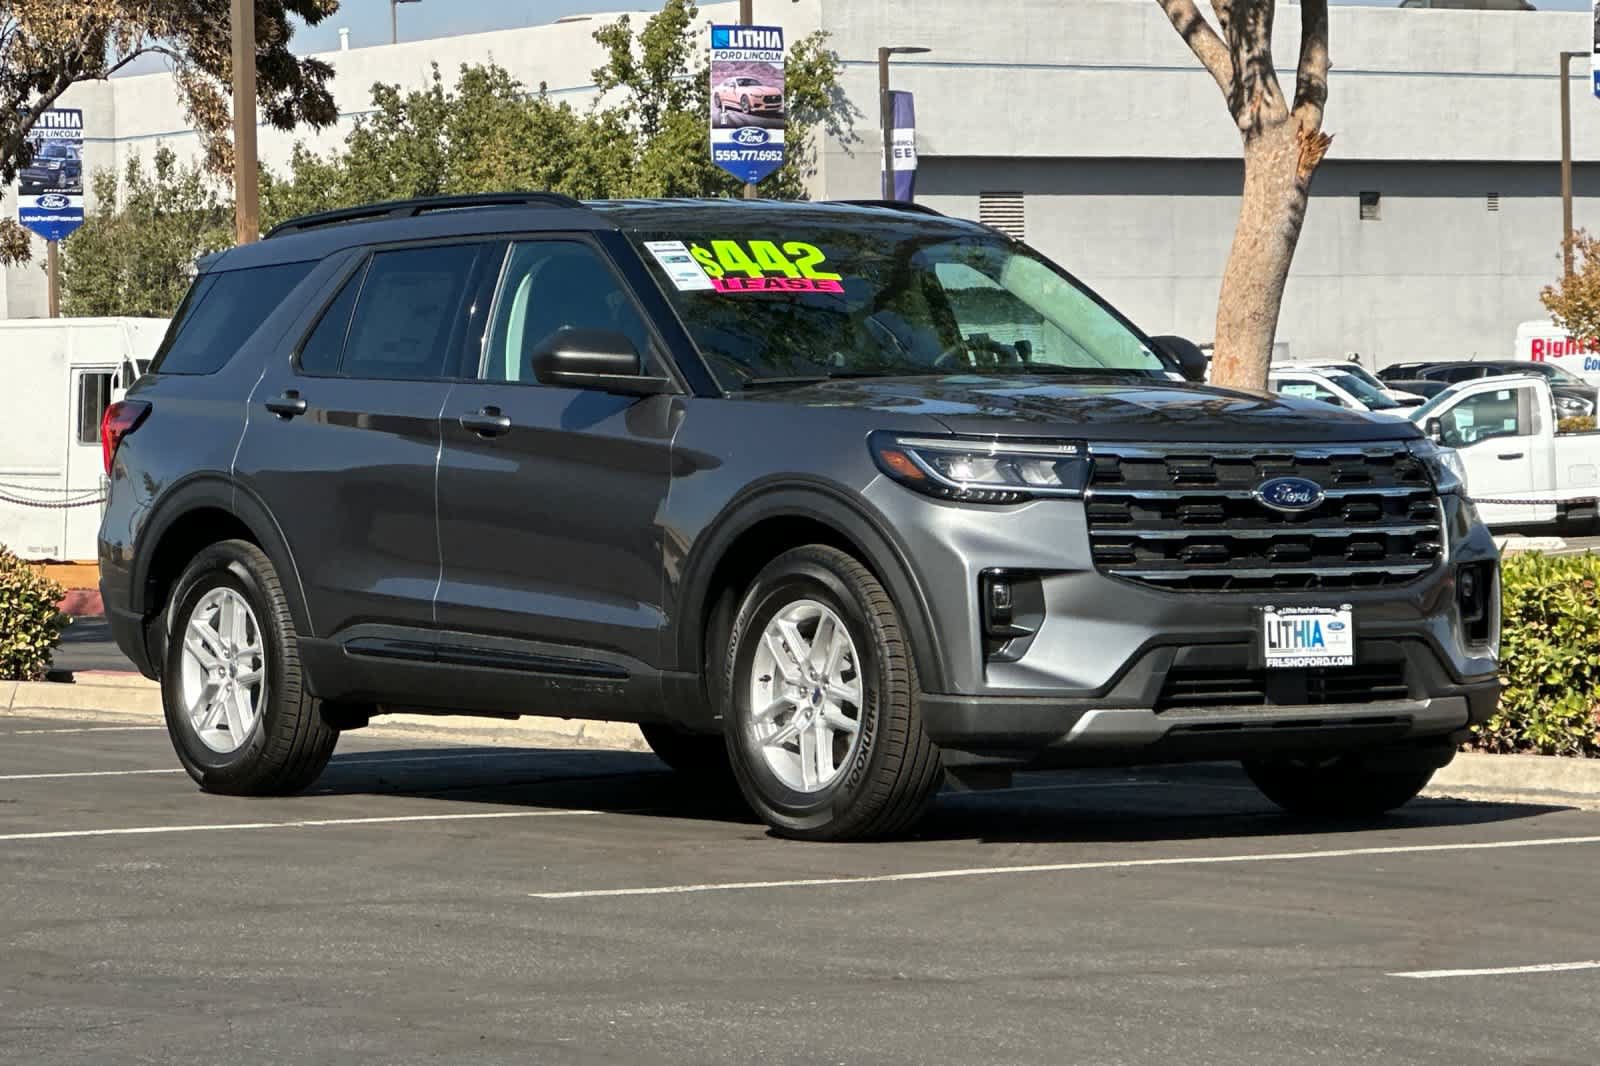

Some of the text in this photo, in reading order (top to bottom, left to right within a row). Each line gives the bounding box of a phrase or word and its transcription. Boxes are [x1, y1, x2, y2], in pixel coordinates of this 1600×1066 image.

[729, 30, 781, 48] LITHIA
[714, 50, 781, 61] FORD LINCOLN
[45, 130, 81, 138] LINCOLN
[738, 128, 765, 143] Ford
[715, 150, 783, 161] 559.777.6952
[41, 195, 66, 208] Ford
[690, 240, 842, 281] $442
[720, 279, 832, 290] LEASE
[1273, 482, 1312, 503] Ford
[1267, 620, 1325, 649] LITHIA
[1266, 656, 1353, 668] FRESNOFORD.COM
